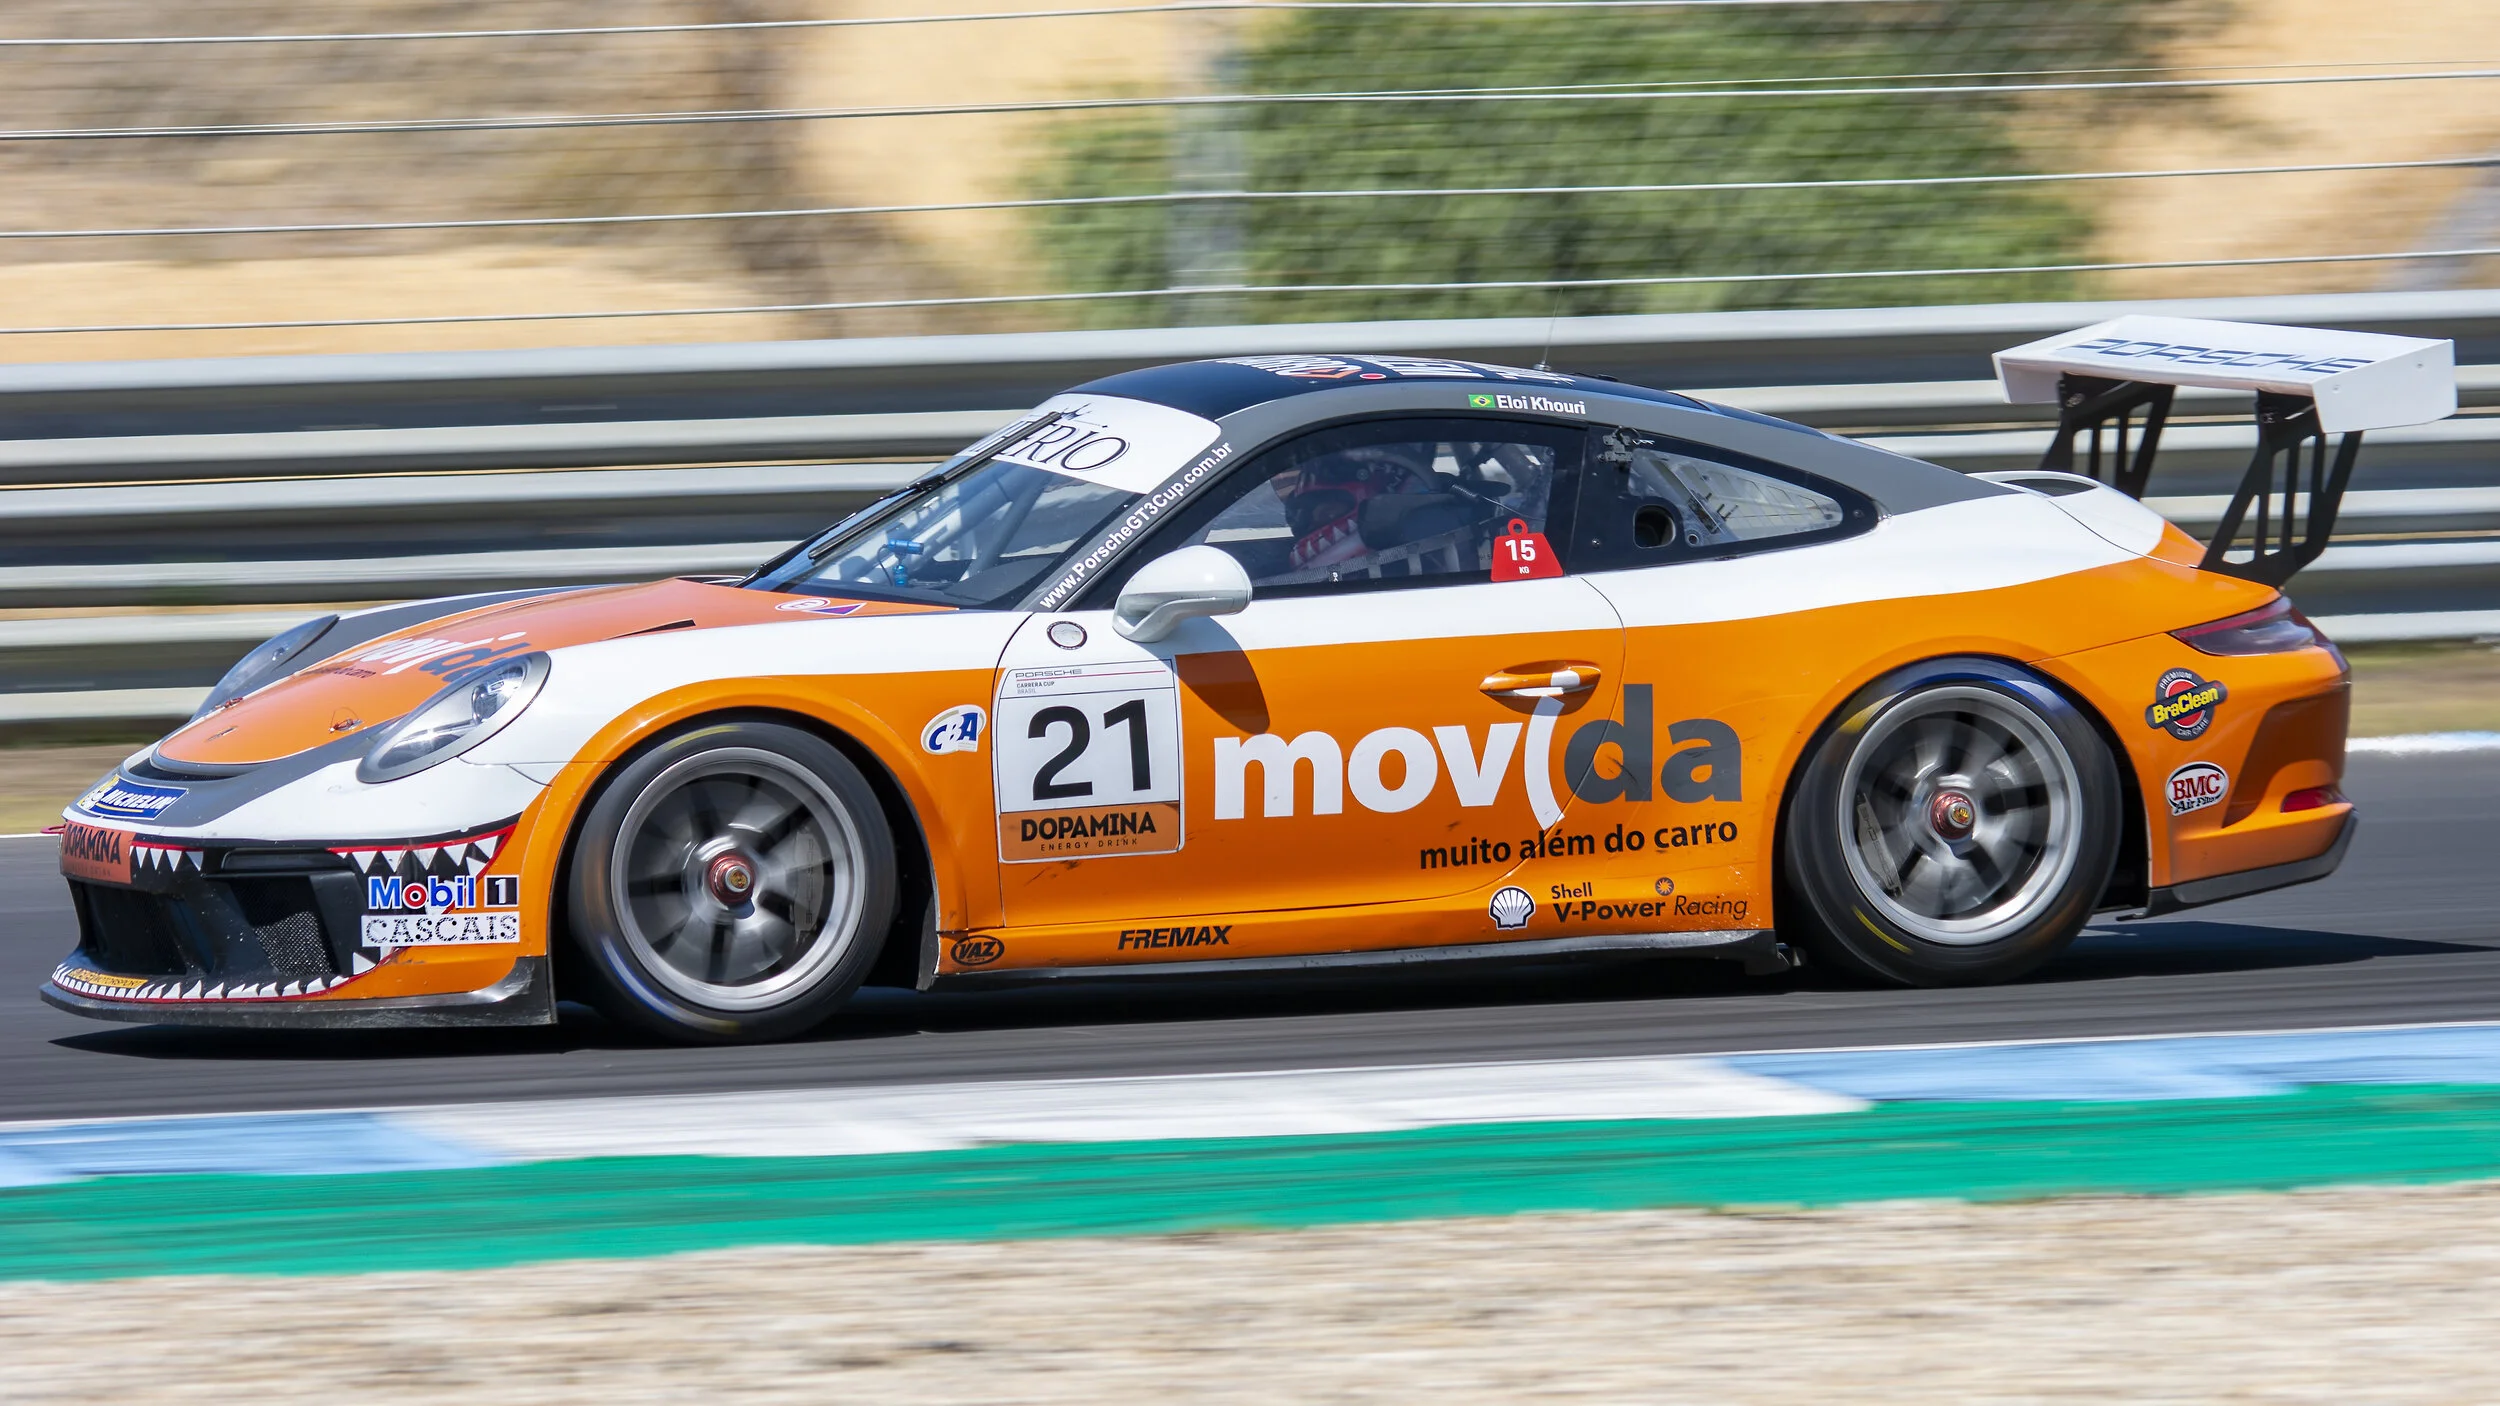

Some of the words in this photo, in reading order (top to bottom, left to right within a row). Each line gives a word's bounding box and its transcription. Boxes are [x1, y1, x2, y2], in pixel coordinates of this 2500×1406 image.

[2055, 338, 2375, 374] PORSCHE
[1496, 394, 1528, 409] Eloi
[1530, 396, 1586, 414] Khouri
[1040, 442, 1233, 609] www.PorscheGT3Cup.com.br
[1505, 539, 1537, 562] 15
[1519, 566, 1530, 575] KG
[1015, 669, 1082, 678] PORSCHE
[2154, 687, 2218, 723] BraClean
[929, 712, 978, 750] CBA
[1028, 699, 1151, 800] 21
[101, 788, 177, 810] MICHELIN
[2172, 774, 2220, 800] BMC
[2174, 799, 2195, 814] Air
[1021, 811, 1157, 842] DOPAMINA
[65, 824, 122, 865] DOPAMINA
[1041, 841, 1089, 851] ENERGY
[1098, 838, 1138, 848] DRINK
[1420, 836, 1511, 869] muito
[1519, 824, 1595, 859] além
[1604, 823, 1645, 853] do
[1653, 820, 1738, 850] carro
[369, 875, 477, 909] Mobil
[1551, 881, 1593, 900] Shell
[1553, 899, 1666, 923] V-Power
[1674, 895, 1748, 919] Racing
[366, 915, 518, 944] CASCAIS
[1117, 925, 1233, 950] FREMAX
[958, 941, 996, 959] VAZ
